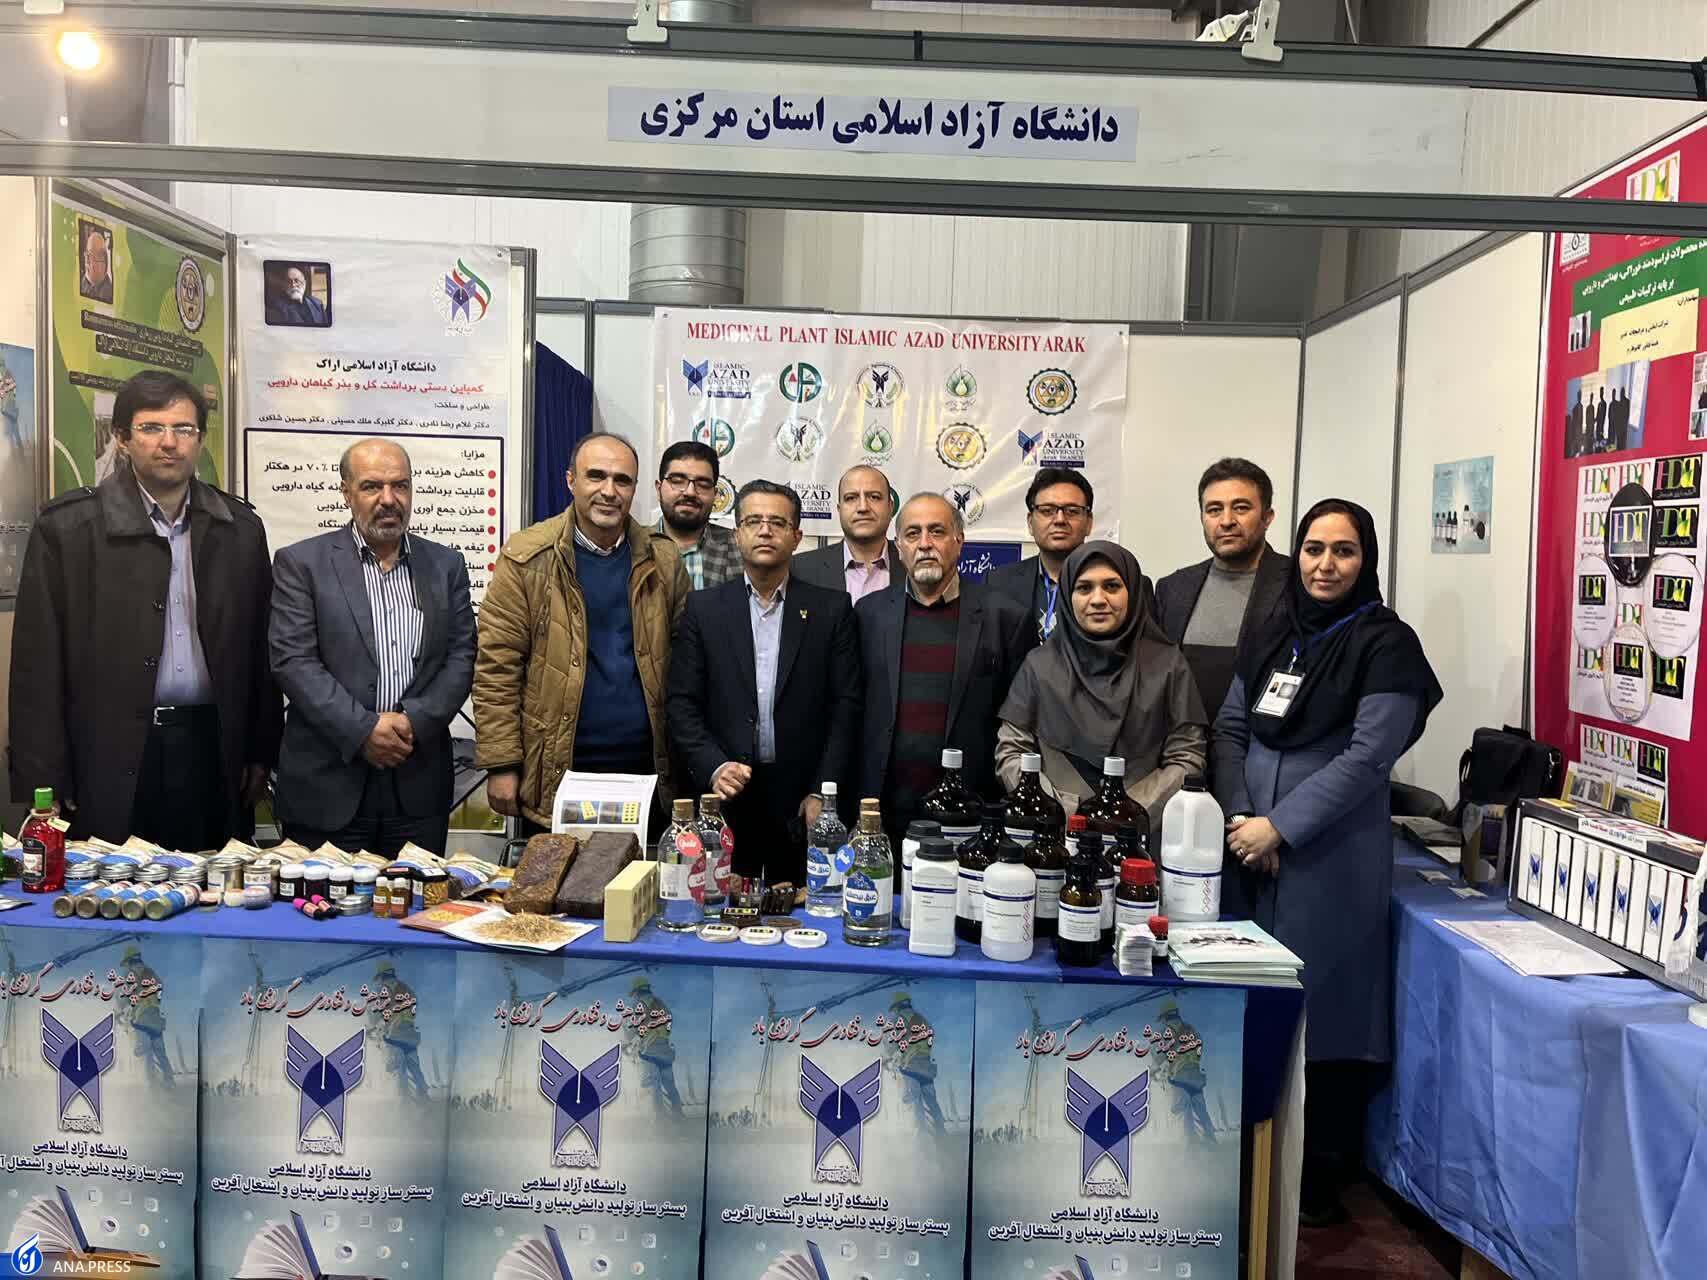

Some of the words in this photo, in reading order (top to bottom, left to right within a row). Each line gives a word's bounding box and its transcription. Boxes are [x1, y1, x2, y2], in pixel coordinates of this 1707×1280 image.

[640, 92, 738, 139] مرکزی
[746, 95, 825, 140] استان
[832, 97, 933, 144] اسلامی
[1012, 105, 1119, 143] دانشگاه
[940, 101, 1006, 150] آزاد
[688, 322, 772, 342] MEDICINAL
[779, 326, 828, 344] PLANT
[835, 328, 898, 347] ISLAMIC
[904, 331, 944, 348] AZAD
[952, 333, 1041, 351] UNIVERSITY
[1043, 337, 1087, 352] ARAK
[316, 359, 340, 371] اراک
[343, 360, 375, 371] اسلامی
[378, 360, 399, 374] آزاد
[401, 361, 436, 372] دانشگاه
[709, 369, 750, 379] AZAD
[267, 378, 298, 388] دارویی
[354, 382, 360, 390] و
[380, 381, 417, 392] برداشت
[420, 383, 447, 393] دستی
[1044, 440, 1085, 449] AZAD
[1047, 432, 1080, 440] ISLAMIC
[263, 461, 290, 472] هکتار
[425, 467, 451, 478] هزینه
[454, 467, 485, 478] کاهش
[1656, 456, 1702, 490] HDT
[272, 481, 303, 491] دارویی
[416, 485, 452, 497] برداشت
[455, 487, 485, 498] قابلیت
[801, 490, 831, 500] ZAD
[437, 506, 456, 516] جمع
[459, 506, 485, 516] مخزن
[431, 523, 456, 535] بسیار
[459, 525, 485, 535] قیمت
[39, 970, 95, 1002] فناوری
[100, 968, 138, 1006] پژوهش
[240, 986, 254, 1014] باد
[287, 985, 346, 1017] فناوری
[351, 983, 391, 1021] پژوهش
[495, 999, 507, 1029] باد
[541, 999, 601, 1033] فناوری
[607, 998, 647, 1037] پژوهش
[752, 1015, 766, 1044] باد
[800, 1015, 861, 1048] فناوری
[867, 1014, 907, 1052] پژوهش
[1016, 1028, 1031, 1058] باد
[1065, 1025, 1128, 1060] فناوری
[1135, 1024, 1177, 1062] پژوهش
[32, 1140, 69, 1155] اسلامی
[71, 1140, 88, 1158] آزاد
[90, 1143, 128, 1159] دانشگاه
[7, 1154, 45, 1173] اشتغال
[47, 1161, 53, 1175] و
[111, 1164, 136, 1179] تولید
[269, 1162, 305, 1178] اسلامی
[308, 1163, 327, 1181] آزاد
[329, 1165, 372, 1180] دانشگاه
[211, 1173, 241, 1193] آفرین
[242, 1176, 280, 1195] اشتغال
[521, 1177, 561, 1193] اسلامی
[563, 1177, 583, 1194] آزاد
[584, 1179, 627, 1194] دانشگاه
[282, 1186, 288, 1199] و
[351, 1184, 380, 1201] تولید
[462, 1189, 494, 1207] آفرین
[783, 1192, 822, 1208] اسلامی
[825, 1192, 844, 1210] آزاد
[494, 1192, 533, 1211] اشتغال
[535, 1200, 543, 1214] و
[606, 1200, 634, 1217] تولید
[845, 1195, 889, 1210] دانشگاه
[722, 1204, 755, 1223] آفرین
[755, 1207, 795, 1225] اشتغال
[797, 1215, 804, 1229] و
[1050, 1206, 1091, 1222] اسلامی
[1093, 1205, 1113, 1224] آزاد
[1115, 1207, 1159, 1223] دانشگاه
[869, 1215, 896, 1232] تولید
[988, 1221, 1023, 1240] آفرین
[1023, 1222, 1064, 1241] اشتغال
[1065, 1229, 1072, 1243] و
[1139, 1228, 1168, 1246] تولید
